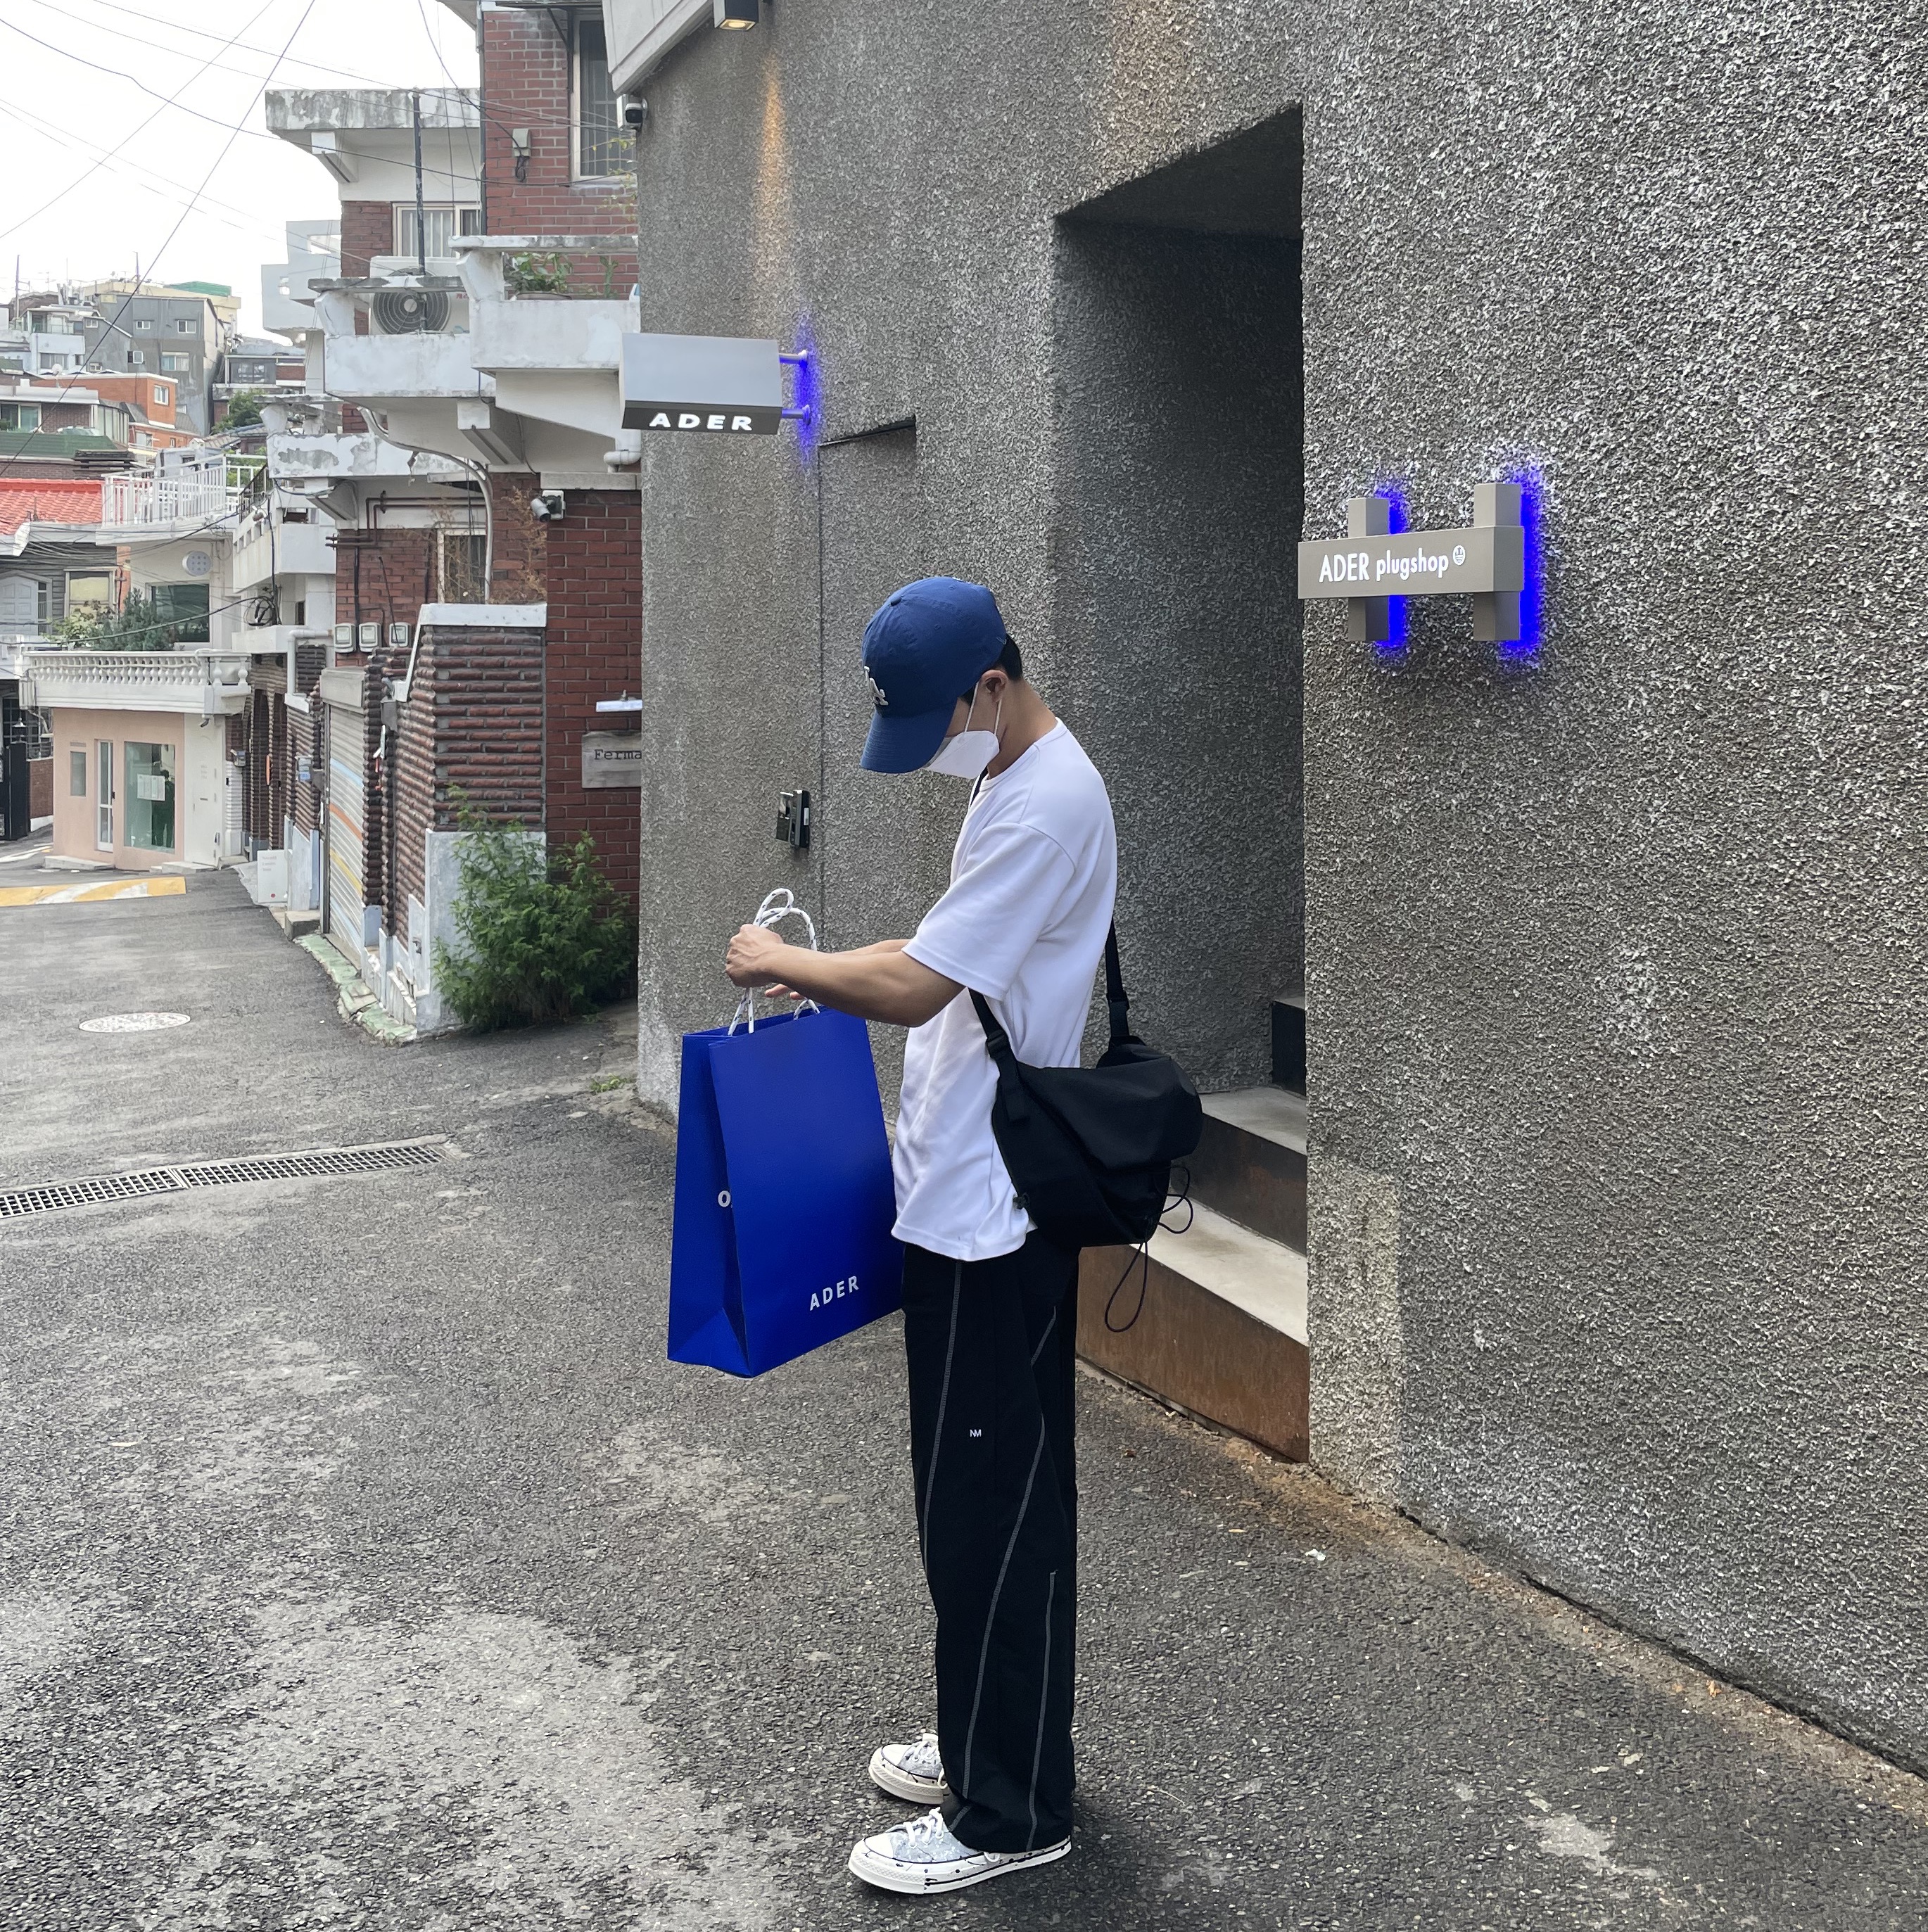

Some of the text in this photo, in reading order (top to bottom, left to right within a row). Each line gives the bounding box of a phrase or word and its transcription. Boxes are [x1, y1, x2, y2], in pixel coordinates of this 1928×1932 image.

[649, 412, 752, 431] ADER
[1319, 547, 1449, 583] ADER plugshop
[810, 1276, 859, 1311] ADER
